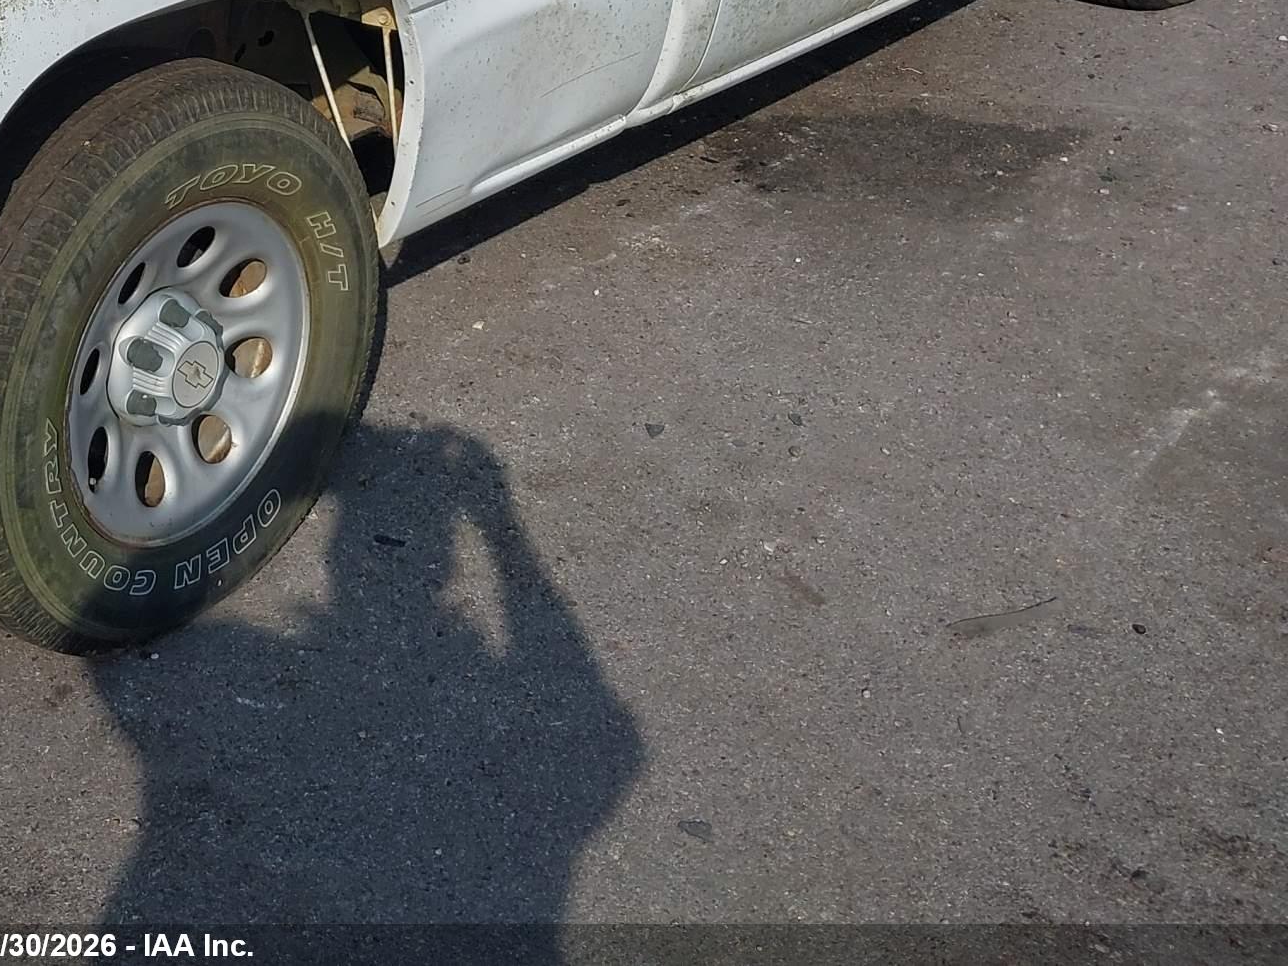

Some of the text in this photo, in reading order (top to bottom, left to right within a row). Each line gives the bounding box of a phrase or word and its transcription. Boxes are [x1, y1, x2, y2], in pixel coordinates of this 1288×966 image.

[164, 163, 302, 210] TOYO
[306, 211, 350, 291] H/T
[44, 417, 282, 596] OPEN COUNTRY
